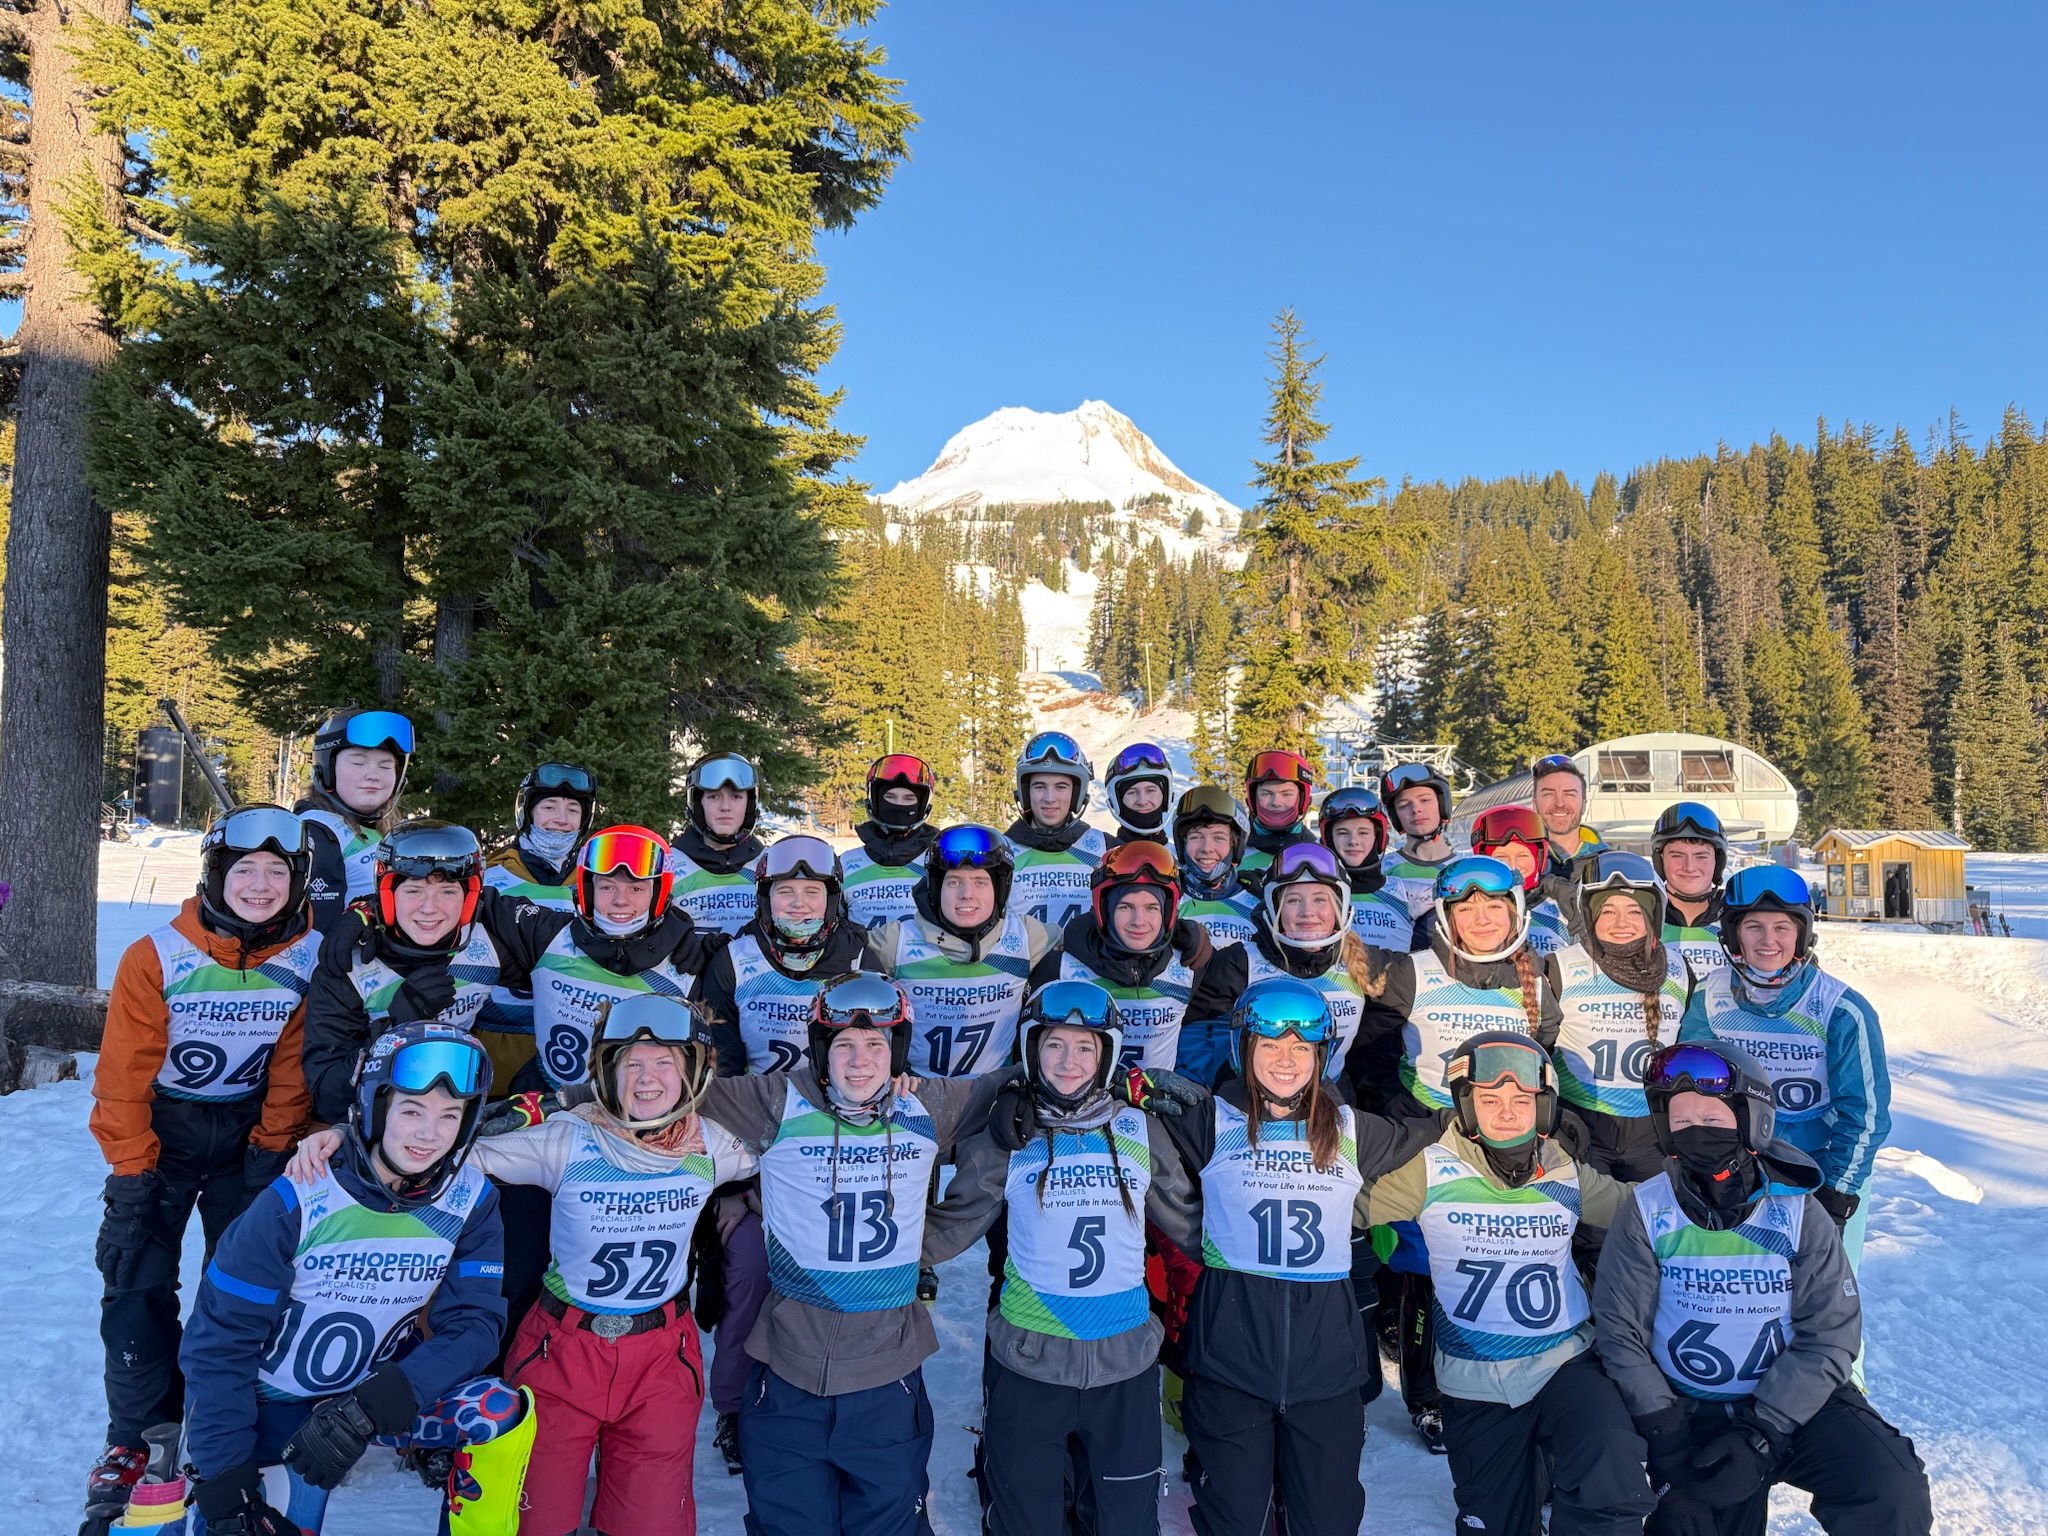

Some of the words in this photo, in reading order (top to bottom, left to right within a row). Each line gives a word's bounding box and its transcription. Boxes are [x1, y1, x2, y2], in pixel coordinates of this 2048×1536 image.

[852, 884, 914, 898] ORTHOPE
[1202, 921, 1250, 933] OPEDIC
[1351, 917, 1396, 929] ACTURE
[1207, 929, 1252, 942] ACTURE
[551, 980, 624, 1005] ORTHOP
[912, 983, 1010, 997] ORTHOPEDIC
[171, 1001, 294, 1013] ORTHOPEDIC
[558, 1001, 601, 1018] SPECIALIST
[747, 1001, 808, 1013] ORTHOP
[1120, 1006, 1173, 1017] OPEDIC
[1578, 1002, 1673, 1012] ORTHOPIC
[557, 1010, 570, 1018] Put
[570, 1013, 588, 1024] Your
[978, 1009, 1001, 1018] Motion
[1122, 1012, 1176, 1027] ACTURE
[1427, 1012, 1527, 1026] ORTHOPEDIC
[184, 1020, 234, 1028] SPECIALISTS
[757, 1019, 798, 1027] SPECIALISTS
[200, 1028, 220, 1037] Your
[248, 1029, 279, 1037] Motion
[771, 1027, 788, 1035] Your
[1142, 1031, 1165, 1040] Motion
[924, 1021, 996, 1077] 17
[1749, 1049, 1824, 1061] RACTURE
[170, 1040, 277, 1090] 94
[1784, 1065, 1812, 1073] Motion
[1229, 1149, 1313, 1162] ORTHOPE
[855, 1175, 869, 1183] Life
[871, 1174, 879, 1182] in
[1241, 1170, 1291, 1179] SPECIALISTS
[1243, 1180, 1257, 1188] Put
[1258, 1181, 1278, 1190] Your
[1280, 1182, 1295, 1190] Life
[1296, 1183, 1305, 1191] in
[1307, 1183, 1333, 1192] Motion
[579, 1187, 695, 1204] ORTHOPEDIC
[1055, 1200, 1075, 1208] Your
[1076, 1199, 1091, 1207] Life
[1101, 1198, 1123, 1206] Motio
[1447, 1211, 1563, 1227] ORTHOPEDIC
[590, 1224, 606, 1234] Put
[607, 1224, 629, 1234] Your
[630, 1223, 646, 1233] Life
[647, 1223, 656, 1231] in
[657, 1221, 686, 1231] Motion
[820, 1190, 899, 1262] 13
[1248, 1198, 1325, 1268] 13
[1462, 1235, 1515, 1245] SPECIALISTS
[1067, 1216, 1106, 1289] 5
[1465, 1245, 1479, 1254] Put
[1480, 1247, 1501, 1256] Your
[1504, 1248, 1520, 1257] Life
[1521, 1249, 1530, 1257] in
[1531, 1249, 1558, 1257] Motion
[303, 1252, 447, 1270] ORTHOPEDIC
[480, 1264, 503, 1275] KARBO
[585, 1239, 677, 1300] 52
[1661, 1265, 1788, 1281] ORTHOPEDIC
[316, 1281, 377, 1290] SPECIALISTS
[334, 1291, 358, 1303] Your
[359, 1295, 378, 1305] Life
[379, 1296, 390, 1305] in
[391, 1295, 423, 1305] Motion
[1453, 1258, 1562, 1329] 70
[1673, 1290, 1727, 1302] SPECIALISTS
[1691, 1303, 1713, 1314] Your
[1715, 1305, 1732, 1314] Life
[1735, 1306, 1744, 1314] in
[1747, 1305, 1781, 1314] Motion
[1415, 1308, 1426, 1345] LEKI
